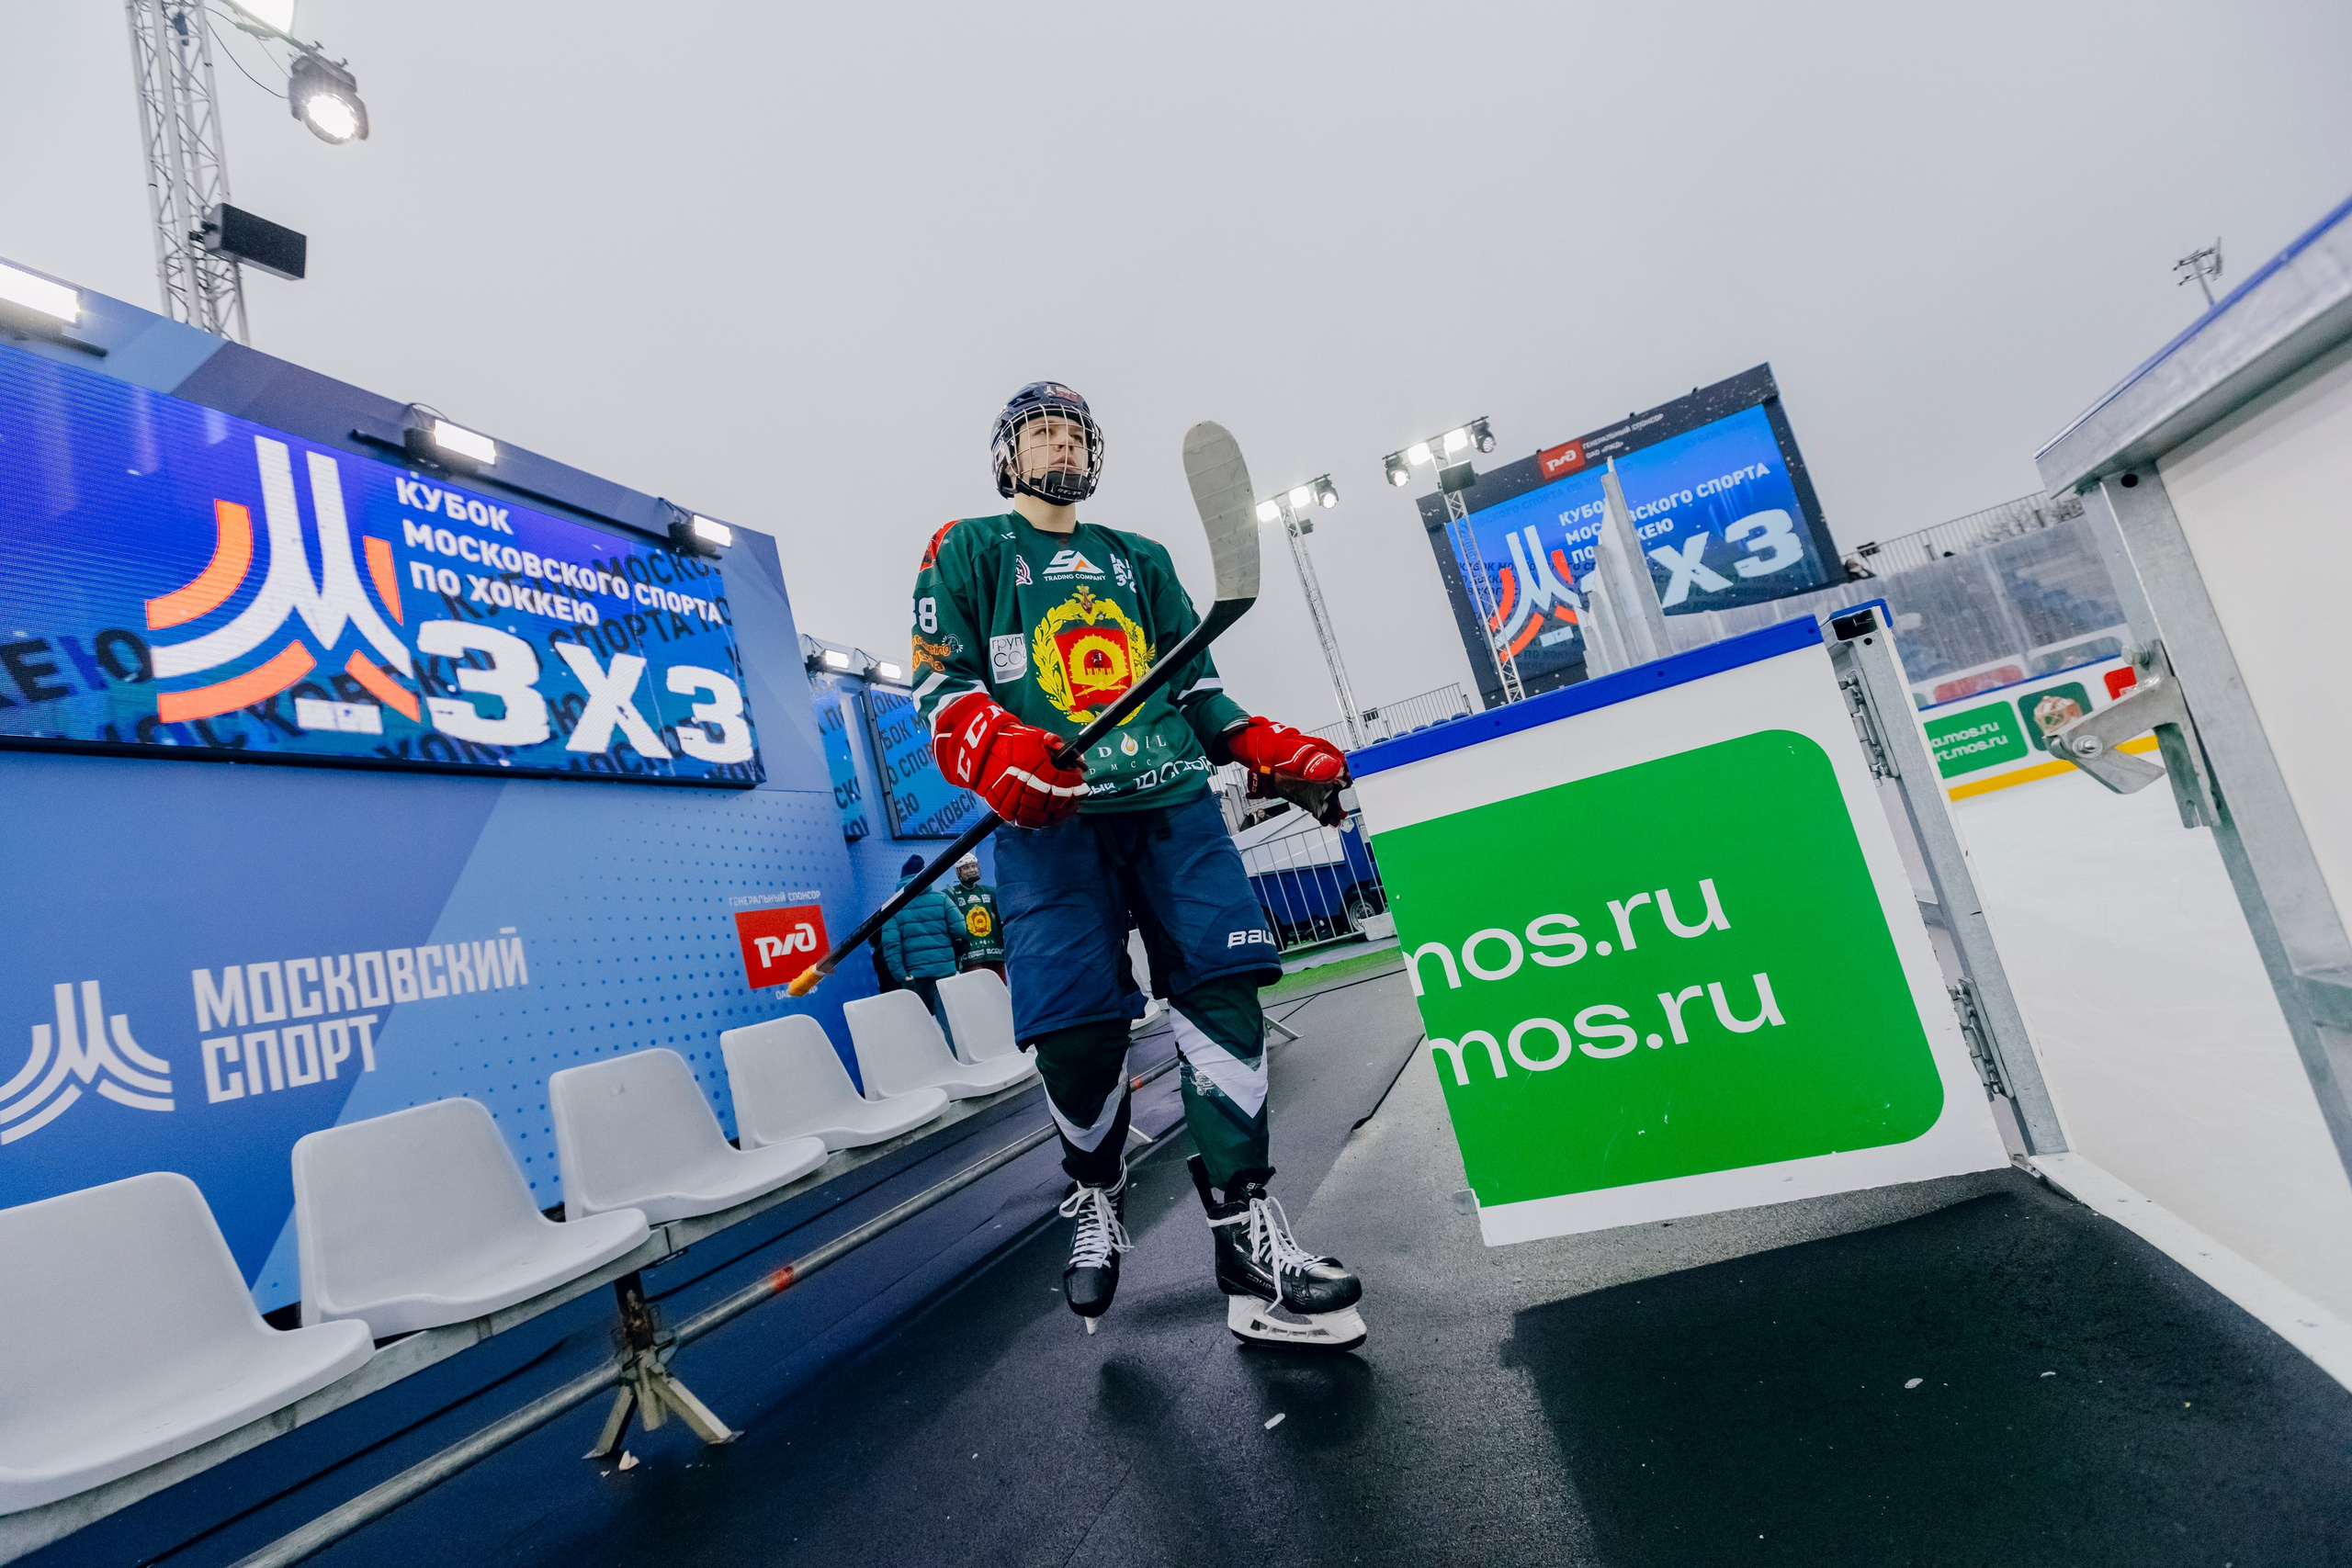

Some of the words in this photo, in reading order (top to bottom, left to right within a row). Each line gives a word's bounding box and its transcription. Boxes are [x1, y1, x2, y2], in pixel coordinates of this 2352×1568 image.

[396, 477, 514, 536] КУБОК
[1696, 462, 1770, 499] СПОРТА
[1558, 499, 1607, 527] КУБО
[402, 519, 630, 600] МОСКОВСКОГО
[634, 582, 723, 625] СПОРТА
[410, 560, 461, 597] ПО
[466, 574, 599, 626] ХОККЕЮ
[1044, 573, 1074, 582] TRADING
[1075, 573, 1106, 581] COMPANY
[912, 597, 938, 634] 8
[729, 891, 786, 907] ГЕНЕРАЛЬНЫЙ
[787, 890, 820, 902] СПОНСОР
[192, 927, 528, 1032] МОСКОВСКИЙ
[1429, 972, 1786, 1086] mos.ru
[201, 1014, 379, 1104] СПОРТ
